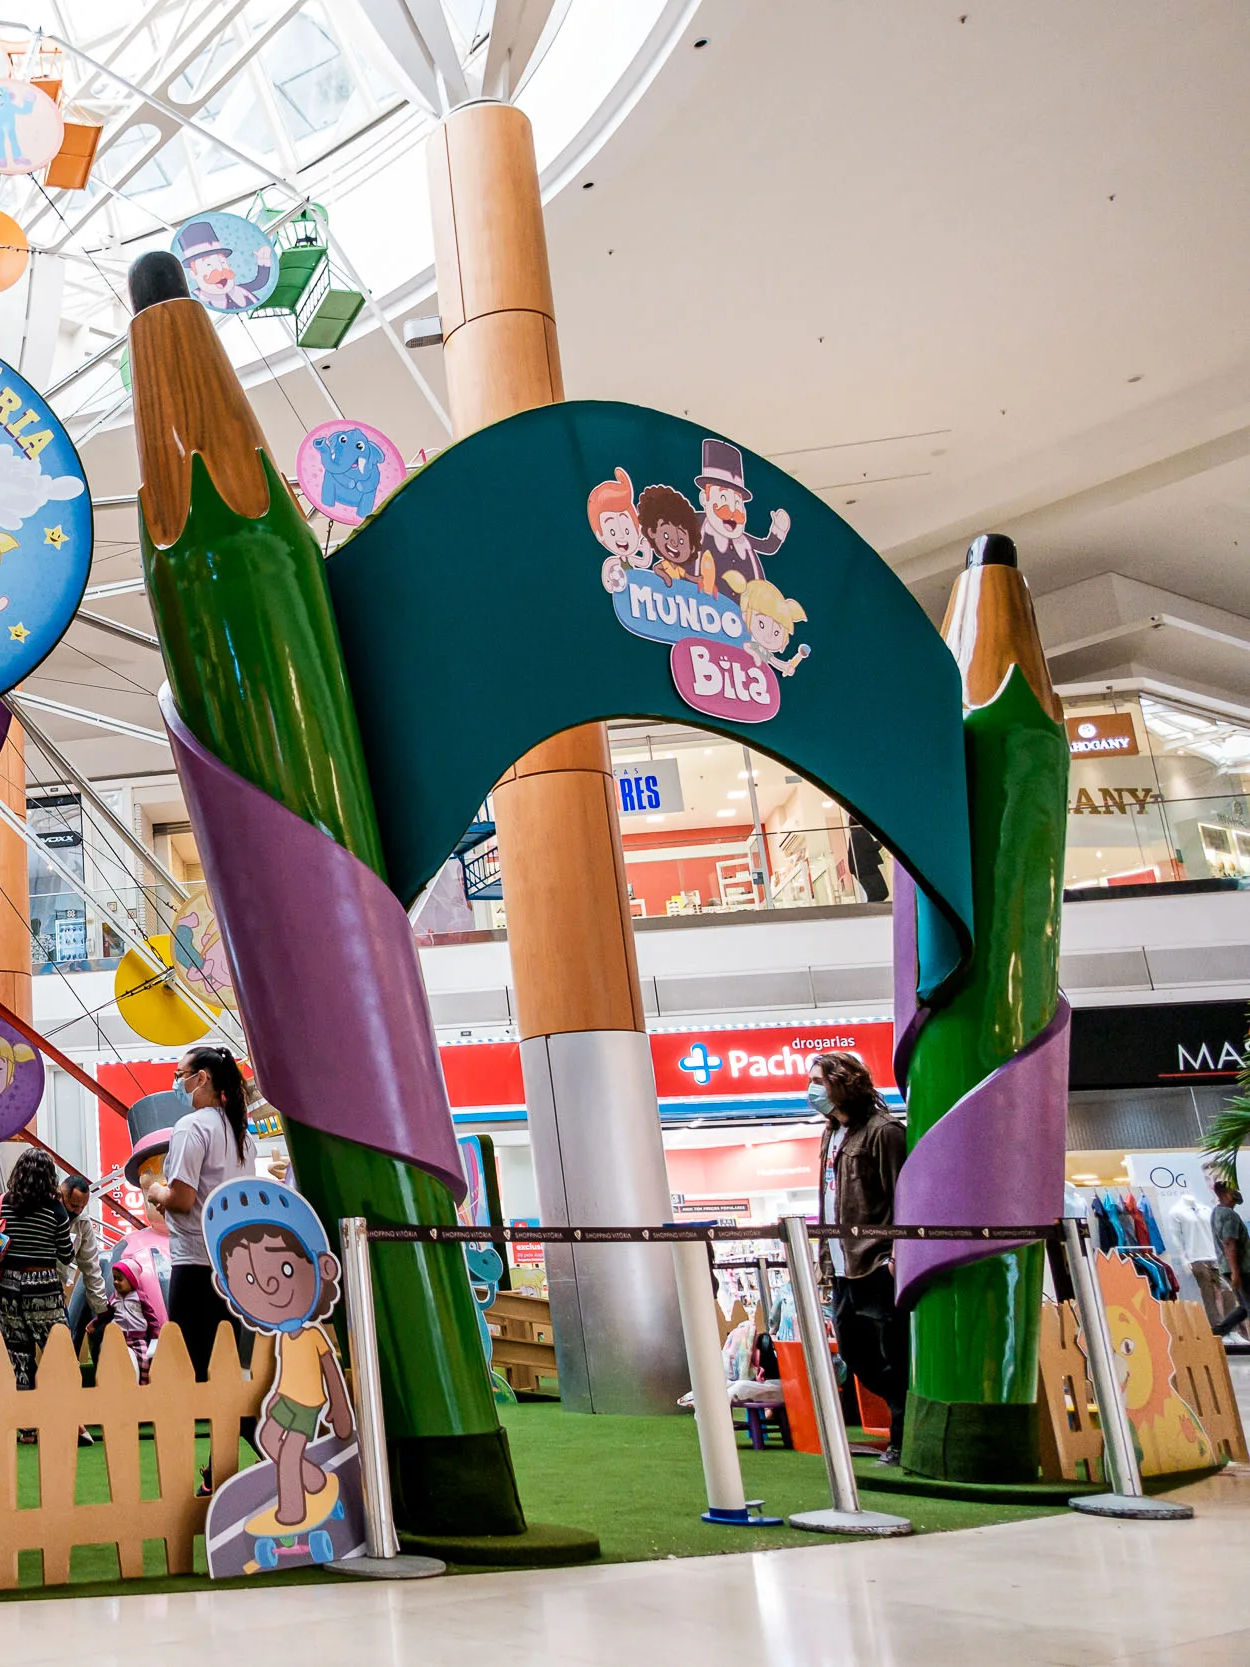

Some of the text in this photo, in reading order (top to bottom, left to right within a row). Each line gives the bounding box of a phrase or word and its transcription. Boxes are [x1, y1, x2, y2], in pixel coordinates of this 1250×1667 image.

[629, 583, 743, 638] MUNDO
[689, 645, 771, 705] Bita
[792, 1035, 856, 1051] drogarias
